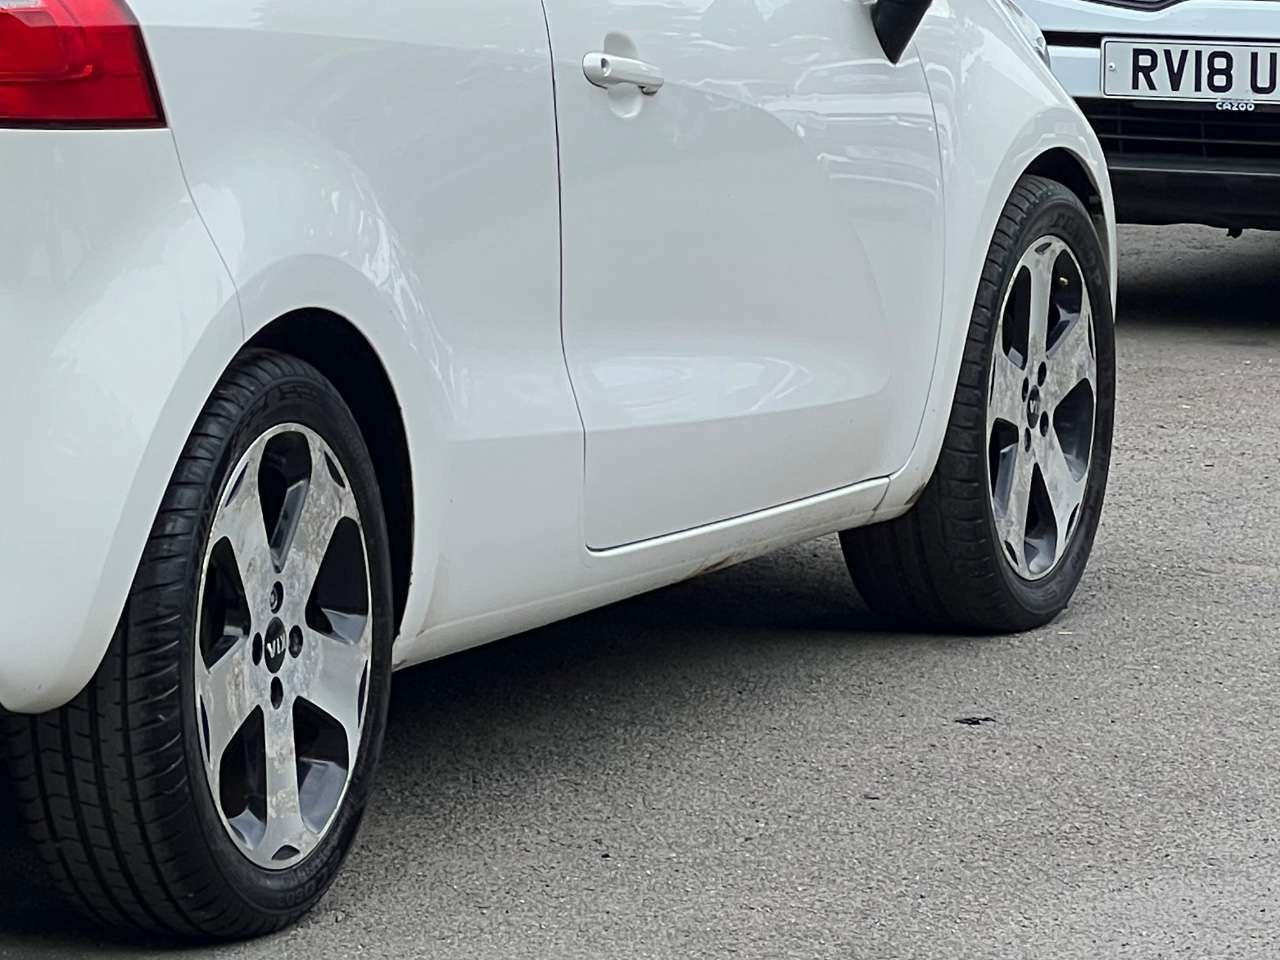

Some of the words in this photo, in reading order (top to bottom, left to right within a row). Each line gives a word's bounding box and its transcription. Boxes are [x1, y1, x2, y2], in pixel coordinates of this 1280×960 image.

[1131, 47, 1234, 93] RV18
[1250, 51, 1277, 95] U
[1215, 101, 1255, 111] CAZOO
